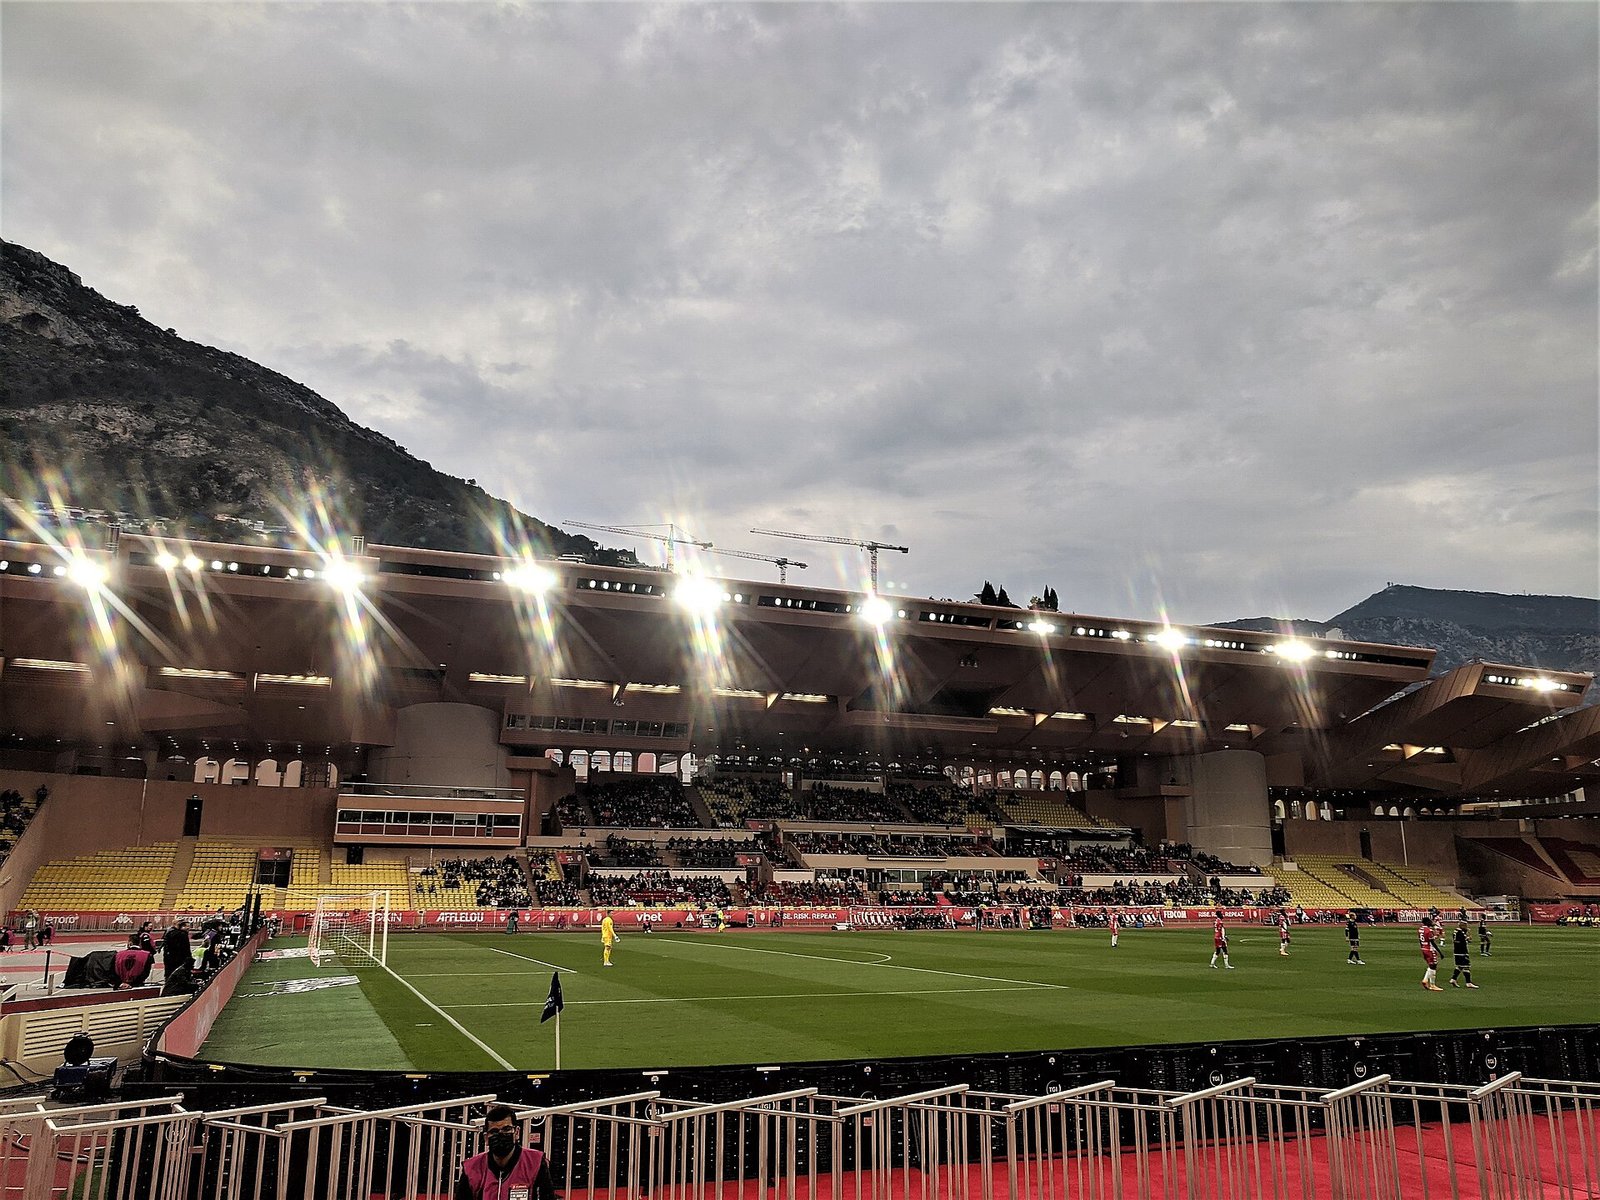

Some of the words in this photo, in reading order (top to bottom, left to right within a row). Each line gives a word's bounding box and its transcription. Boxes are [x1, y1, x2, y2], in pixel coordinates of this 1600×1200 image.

[436, 912, 485, 923] AFFLELOU
[636, 912, 662, 922] vbet
[811, 912, 838, 920] REPEAT.
[1163, 910, 1188, 919] FEDCOM
